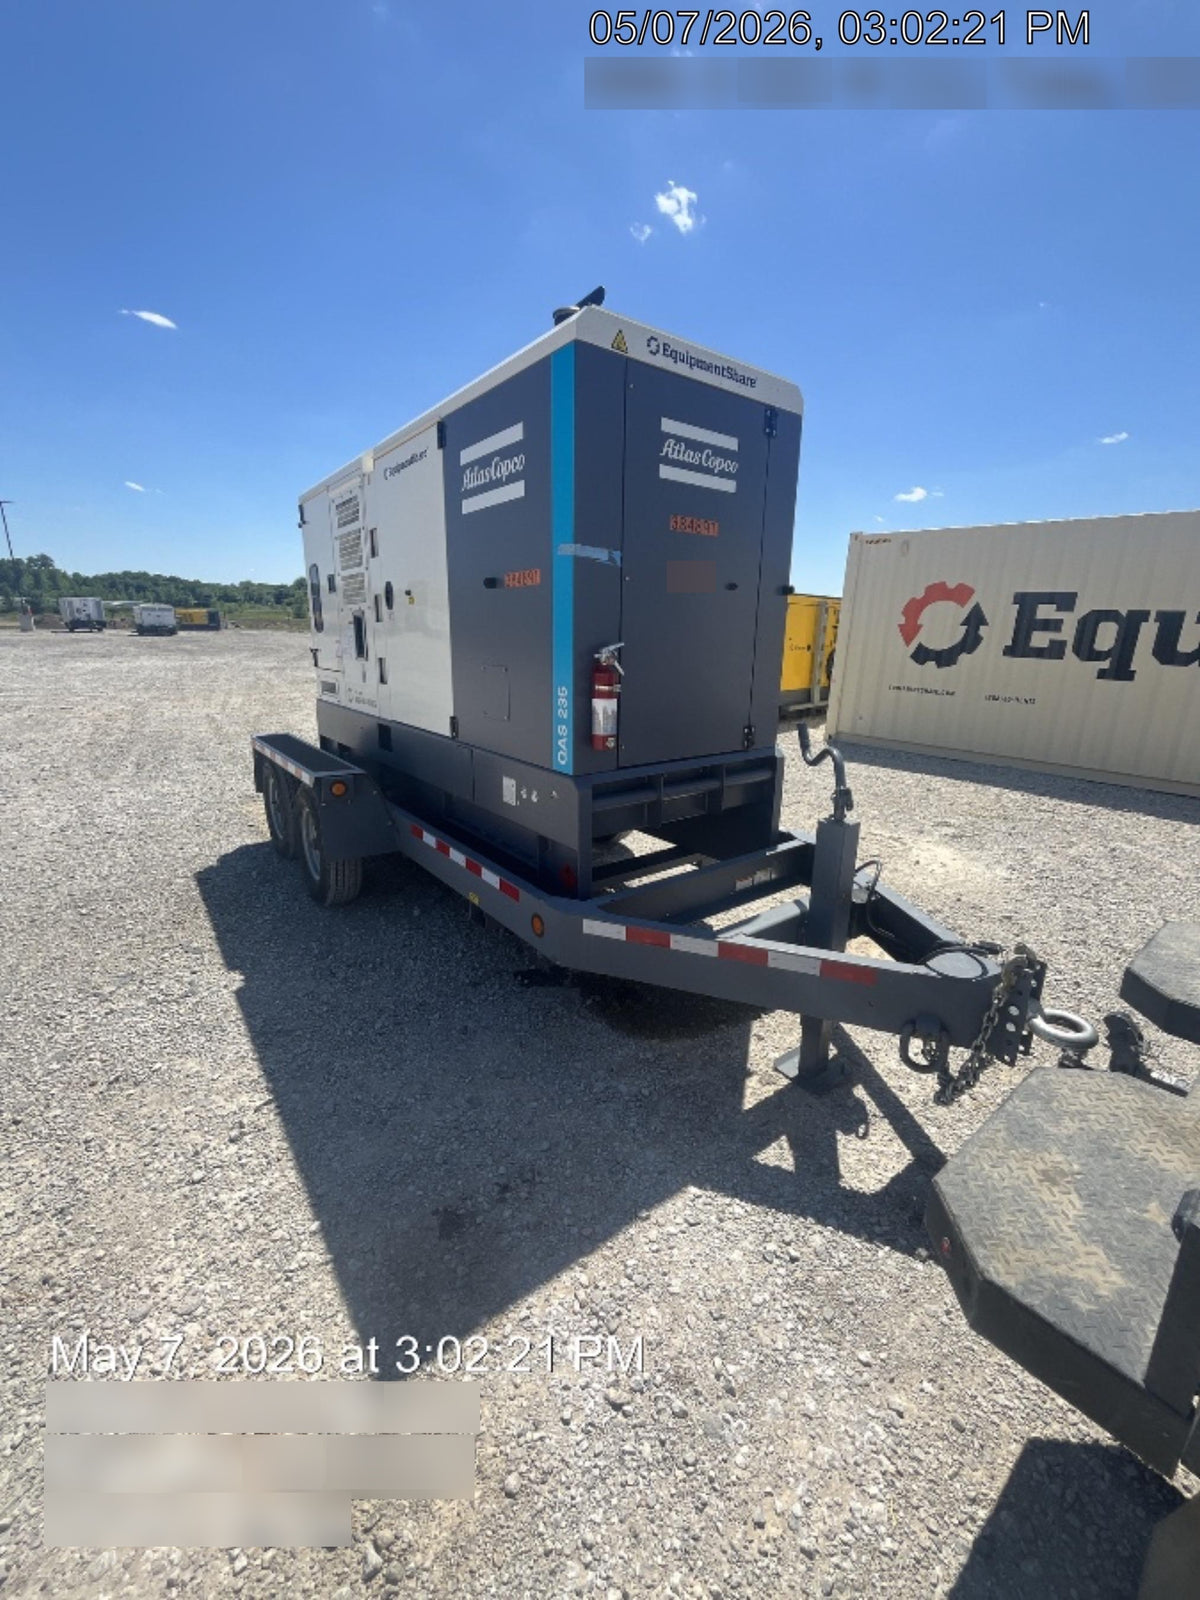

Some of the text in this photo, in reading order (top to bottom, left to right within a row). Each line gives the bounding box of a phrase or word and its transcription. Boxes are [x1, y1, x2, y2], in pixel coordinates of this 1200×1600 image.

[662, 342, 757, 388] EquipmentShare
[461, 454, 525, 491] Atlas Copco
[659, 438, 738, 474] Atlas Copco
[1002, 591, 1200, 682] Equ
[557, 686, 568, 765] QAS 235
